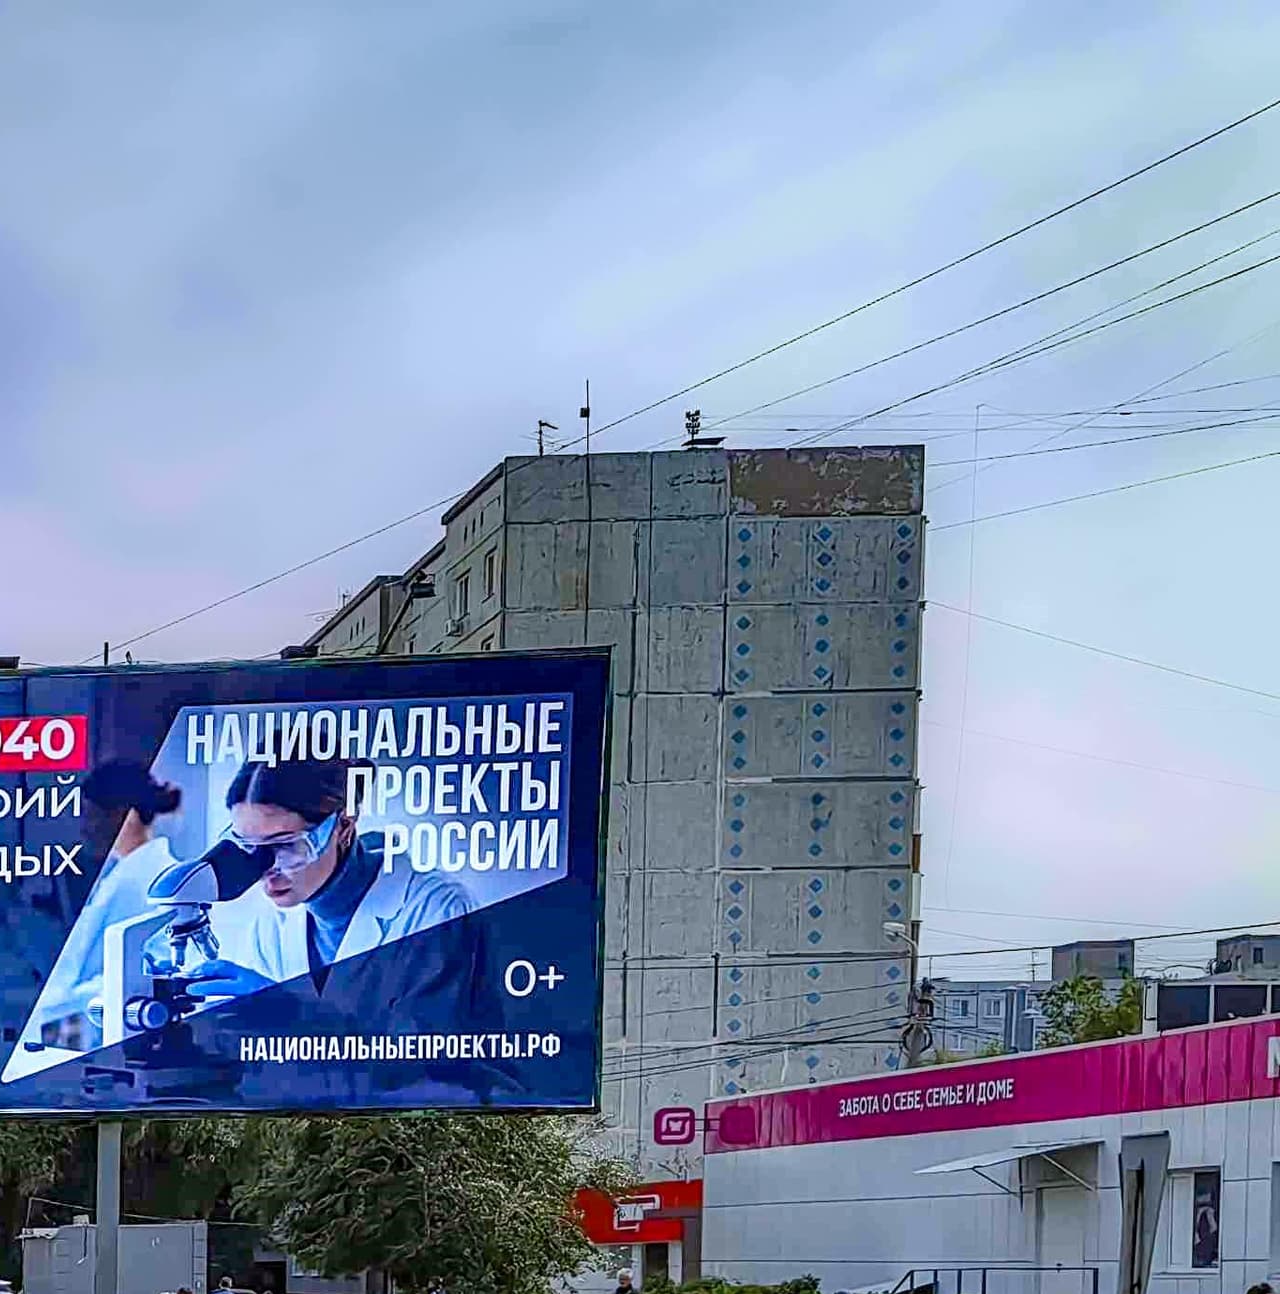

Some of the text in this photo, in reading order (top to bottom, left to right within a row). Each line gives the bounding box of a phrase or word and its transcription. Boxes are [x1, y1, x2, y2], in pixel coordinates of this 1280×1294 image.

[186, 701, 564, 768] НАЦИОНАЛЬНЫЕ
[346, 760, 561, 817] ПРОЕКТЫ
[384, 818, 557, 874] РОССИИ
[503, 959, 565, 997] 0+
[239, 1033, 561, 1063] НАЦИОНАЛЬНЫЕПРОЕКТЫ.РФ
[839, 1078, 1015, 1117] ЗАБОТА О СЕБЕ, СЕМЬЕ И ДОМЕ
